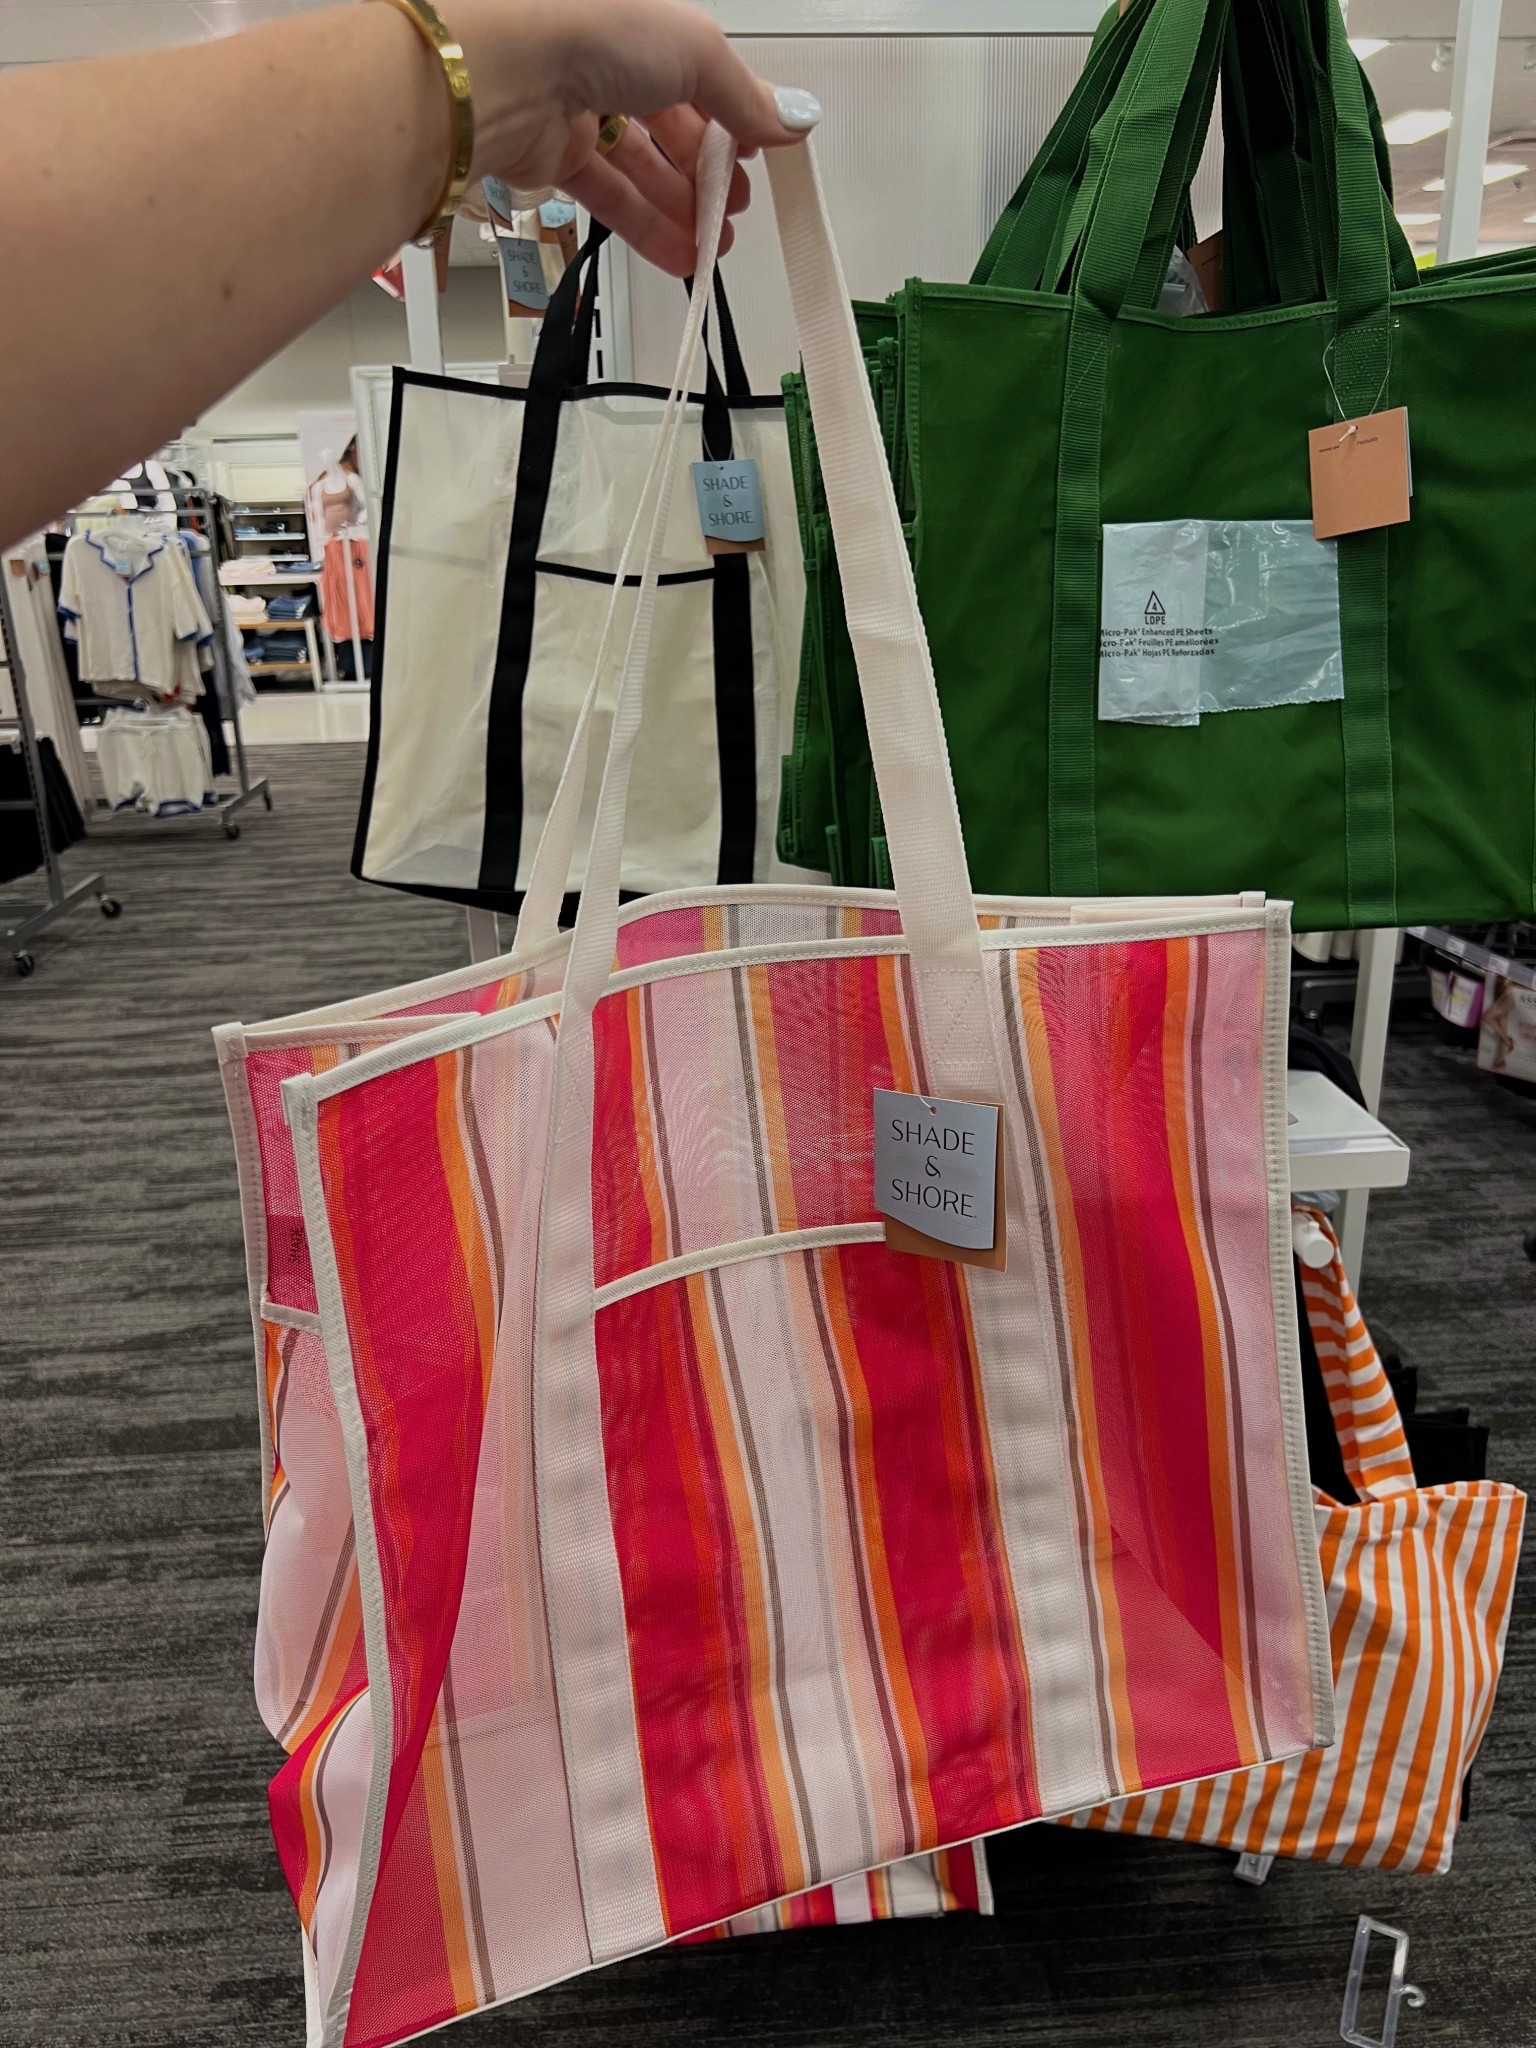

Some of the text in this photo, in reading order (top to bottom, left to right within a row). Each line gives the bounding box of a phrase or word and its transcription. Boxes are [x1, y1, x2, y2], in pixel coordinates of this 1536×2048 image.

[703, 476, 749, 491] SHADE
[723, 495, 733, 507] &
[708, 511, 756, 526] SHORE
[1144, 616, 1166, 625] LDPE
[1141, 628, 1175, 636] Enhanced
[1176, 628, 1184, 636] PE
[1185, 628, 1213, 636] Sheets
[1142, 649, 1161, 658] Hojas
[1162, 649, 1171, 657] PE
[1171, 648, 1215, 657] Reforzadas
[891, 1119, 975, 1156] SHADE
[925, 1155, 941, 1179] &
[891, 1178, 975, 1218] SHORE
